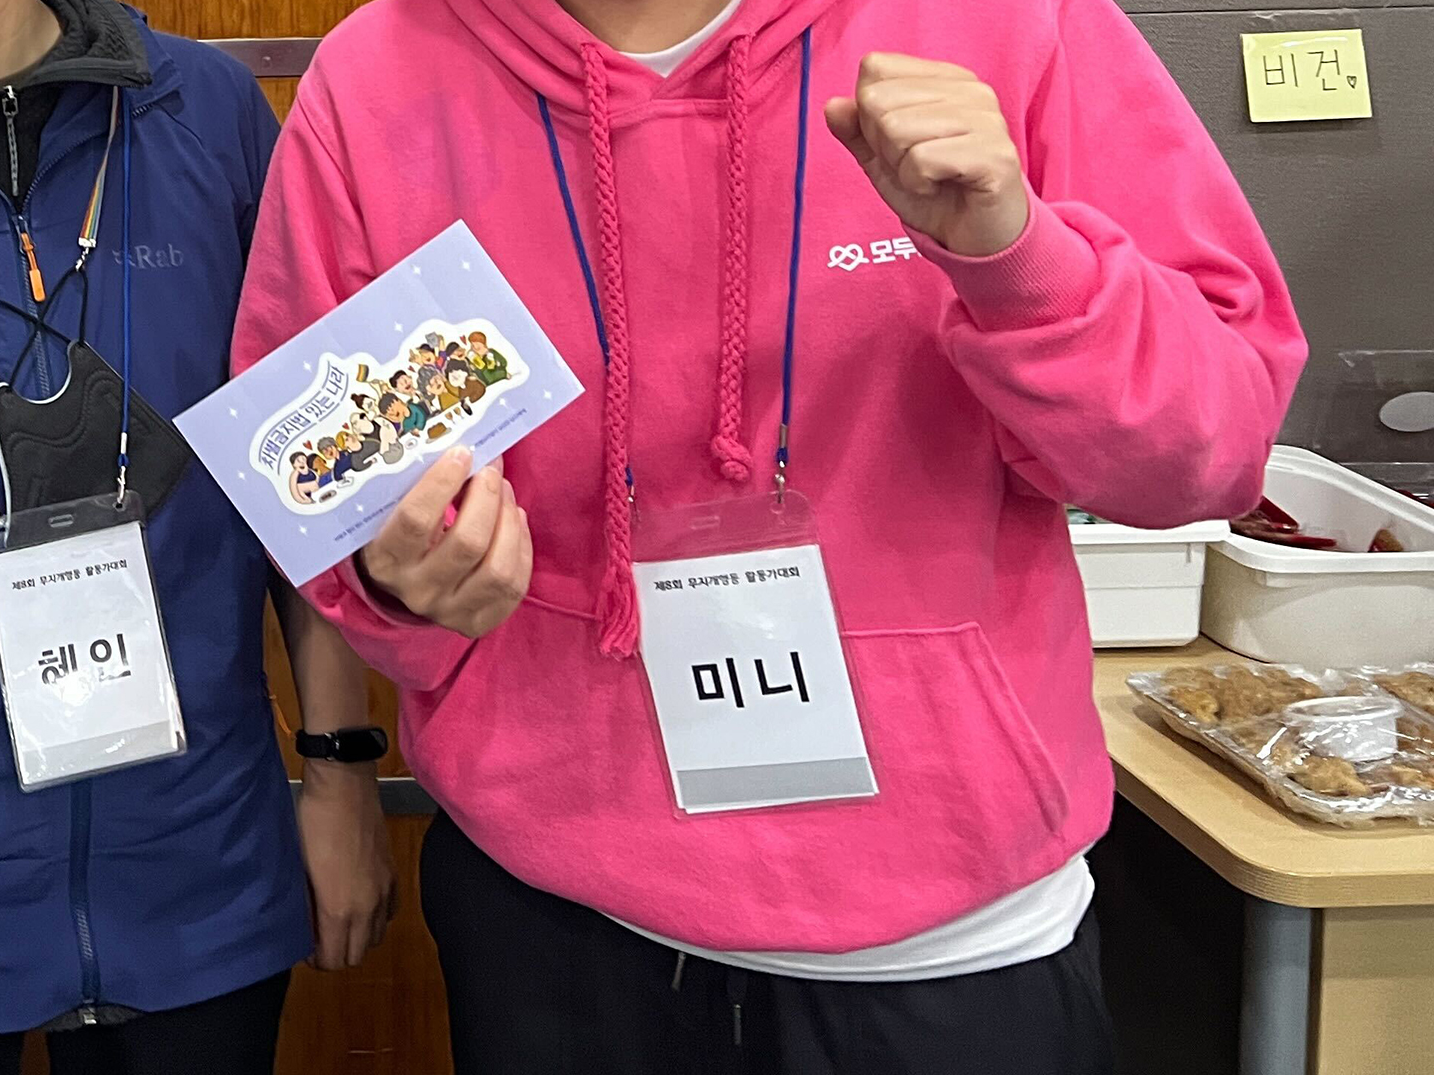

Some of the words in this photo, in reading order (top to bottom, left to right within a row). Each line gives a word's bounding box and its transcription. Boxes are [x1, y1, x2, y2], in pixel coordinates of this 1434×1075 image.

[1263, 49, 1341, 91] 비건
[134, 243, 184, 269] Rab
[870, 236, 923, 264] 모두
[261, 413, 311, 470] 차별금지법
[305, 396, 335, 418] 있는
[326, 365, 345, 396] 나라
[40, 568, 81, 585] 무지개행동
[85, 559, 127, 576] 활동가대회
[688, 572, 740, 589] 무지개행동
[745, 566, 801, 584] 활동가대회
[38, 633, 132, 686] 혜인
[691, 651, 810, 709] 미니
